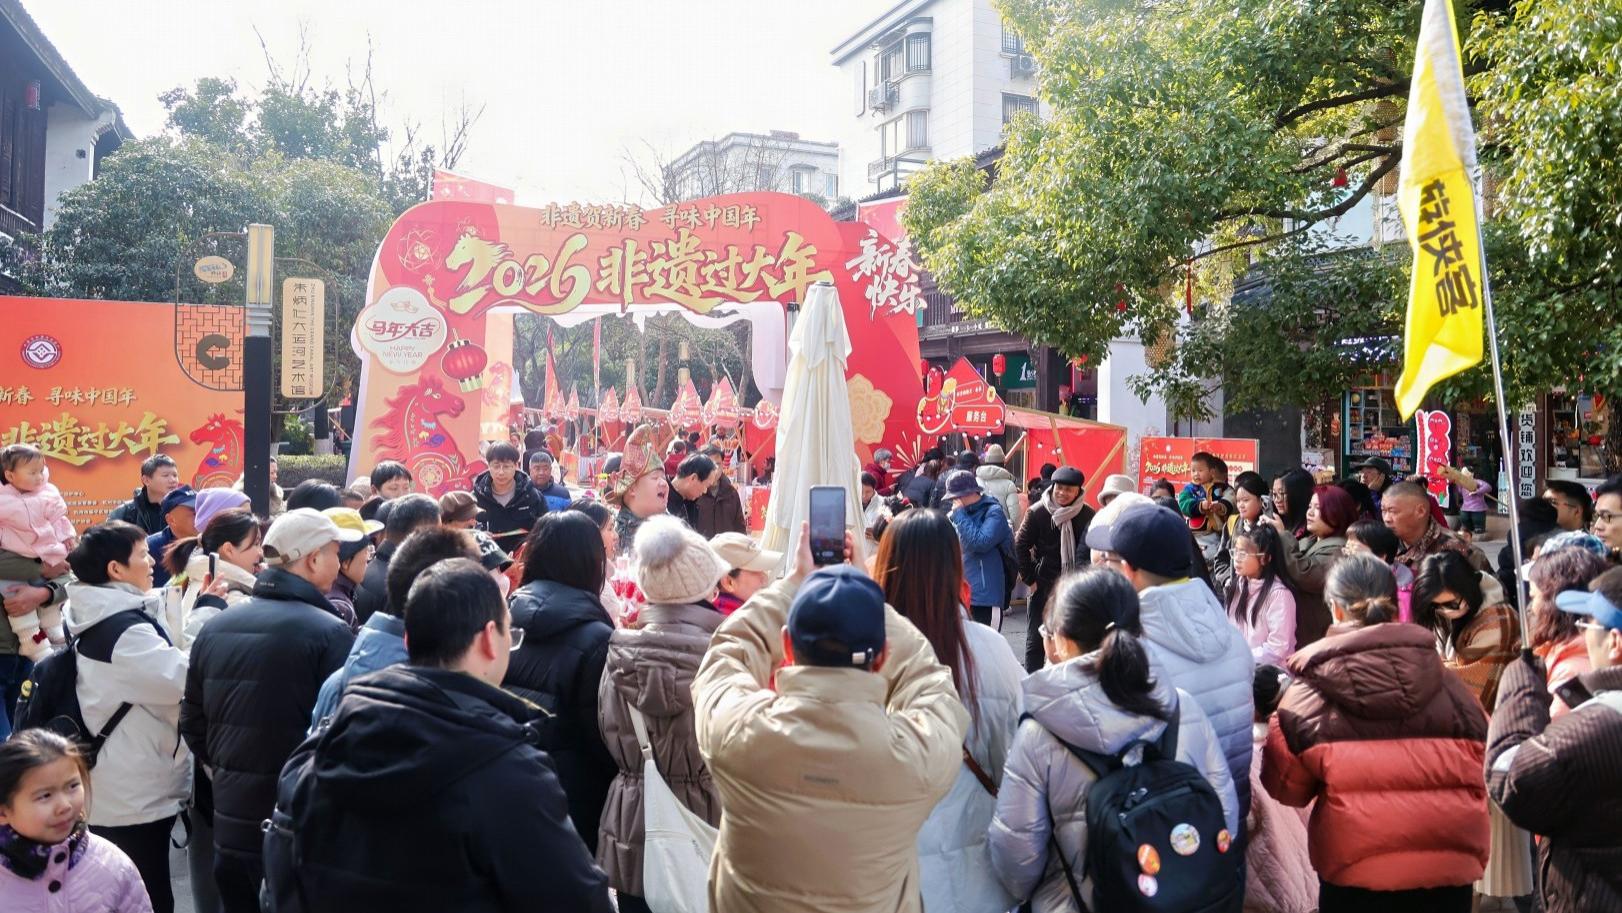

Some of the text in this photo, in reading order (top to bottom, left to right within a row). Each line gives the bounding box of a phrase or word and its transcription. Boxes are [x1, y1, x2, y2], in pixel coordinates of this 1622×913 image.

[541, 202, 761, 231] 非遗贺新春 寻味中国年
[445, 228, 835, 319] 2026 非遗过大年
[846, 230, 921, 281] 新春
[865, 275, 927, 321] 快乐
[370, 319, 438, 340] 马年大吉
[45, 386, 137, 407] 寻味中国年
[966, 410, 987, 422] 服务台
[2, 411, 181, 466] 非遗过大年
